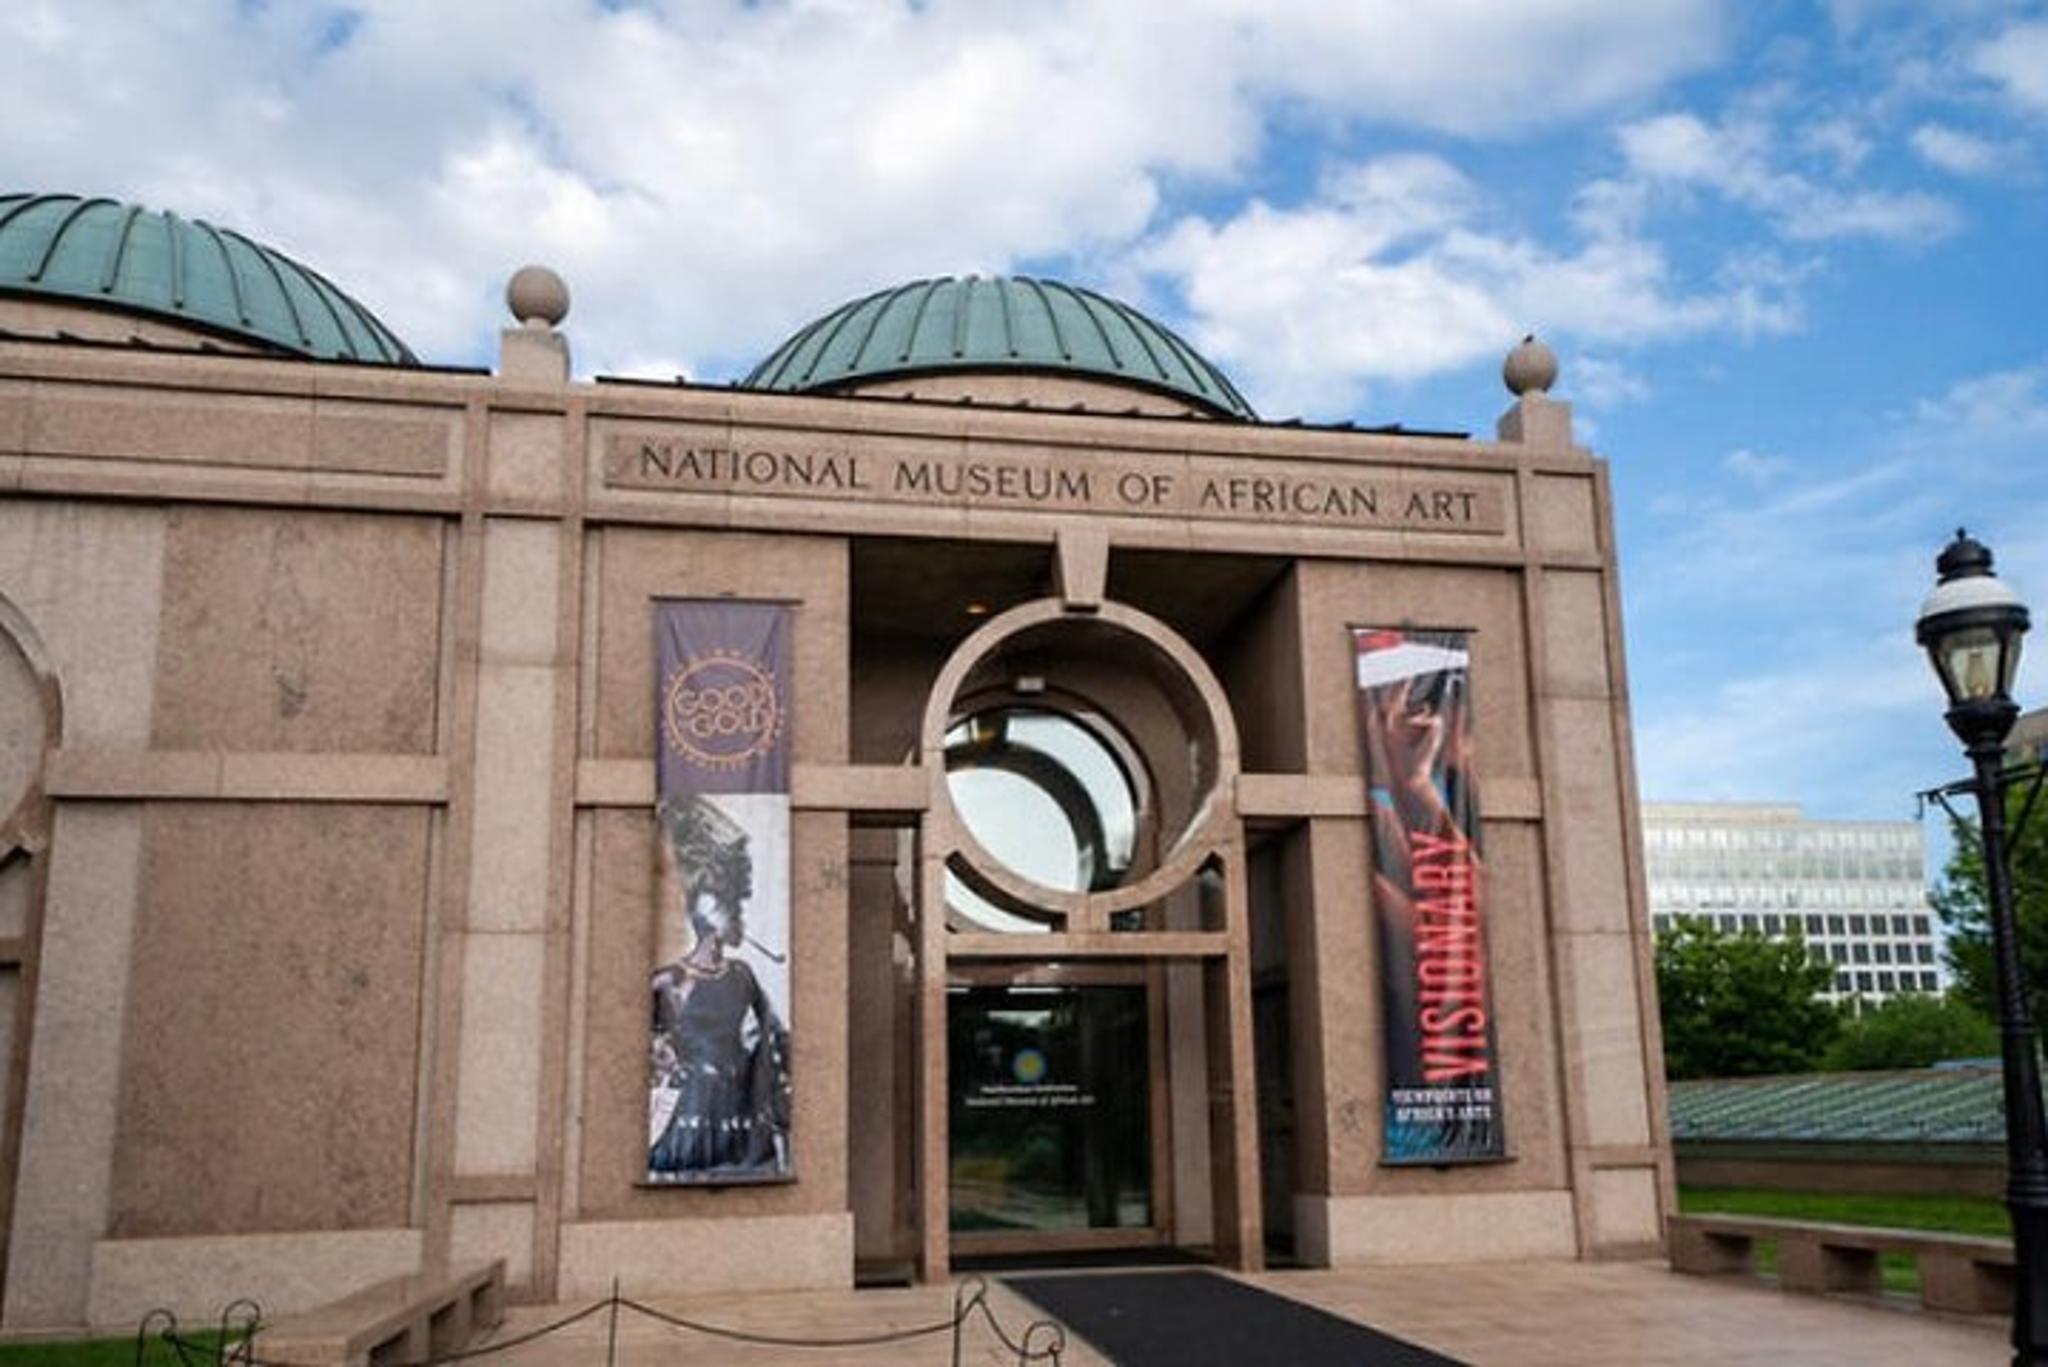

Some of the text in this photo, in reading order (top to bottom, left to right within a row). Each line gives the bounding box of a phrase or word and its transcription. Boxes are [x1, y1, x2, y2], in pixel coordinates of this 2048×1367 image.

[638, 443, 1479, 523] NATIONAL MUSEUM OF AFRICAN ART
[676, 682, 768, 716] GOOD
[1410, 829, 1489, 1083] VISIONARY
